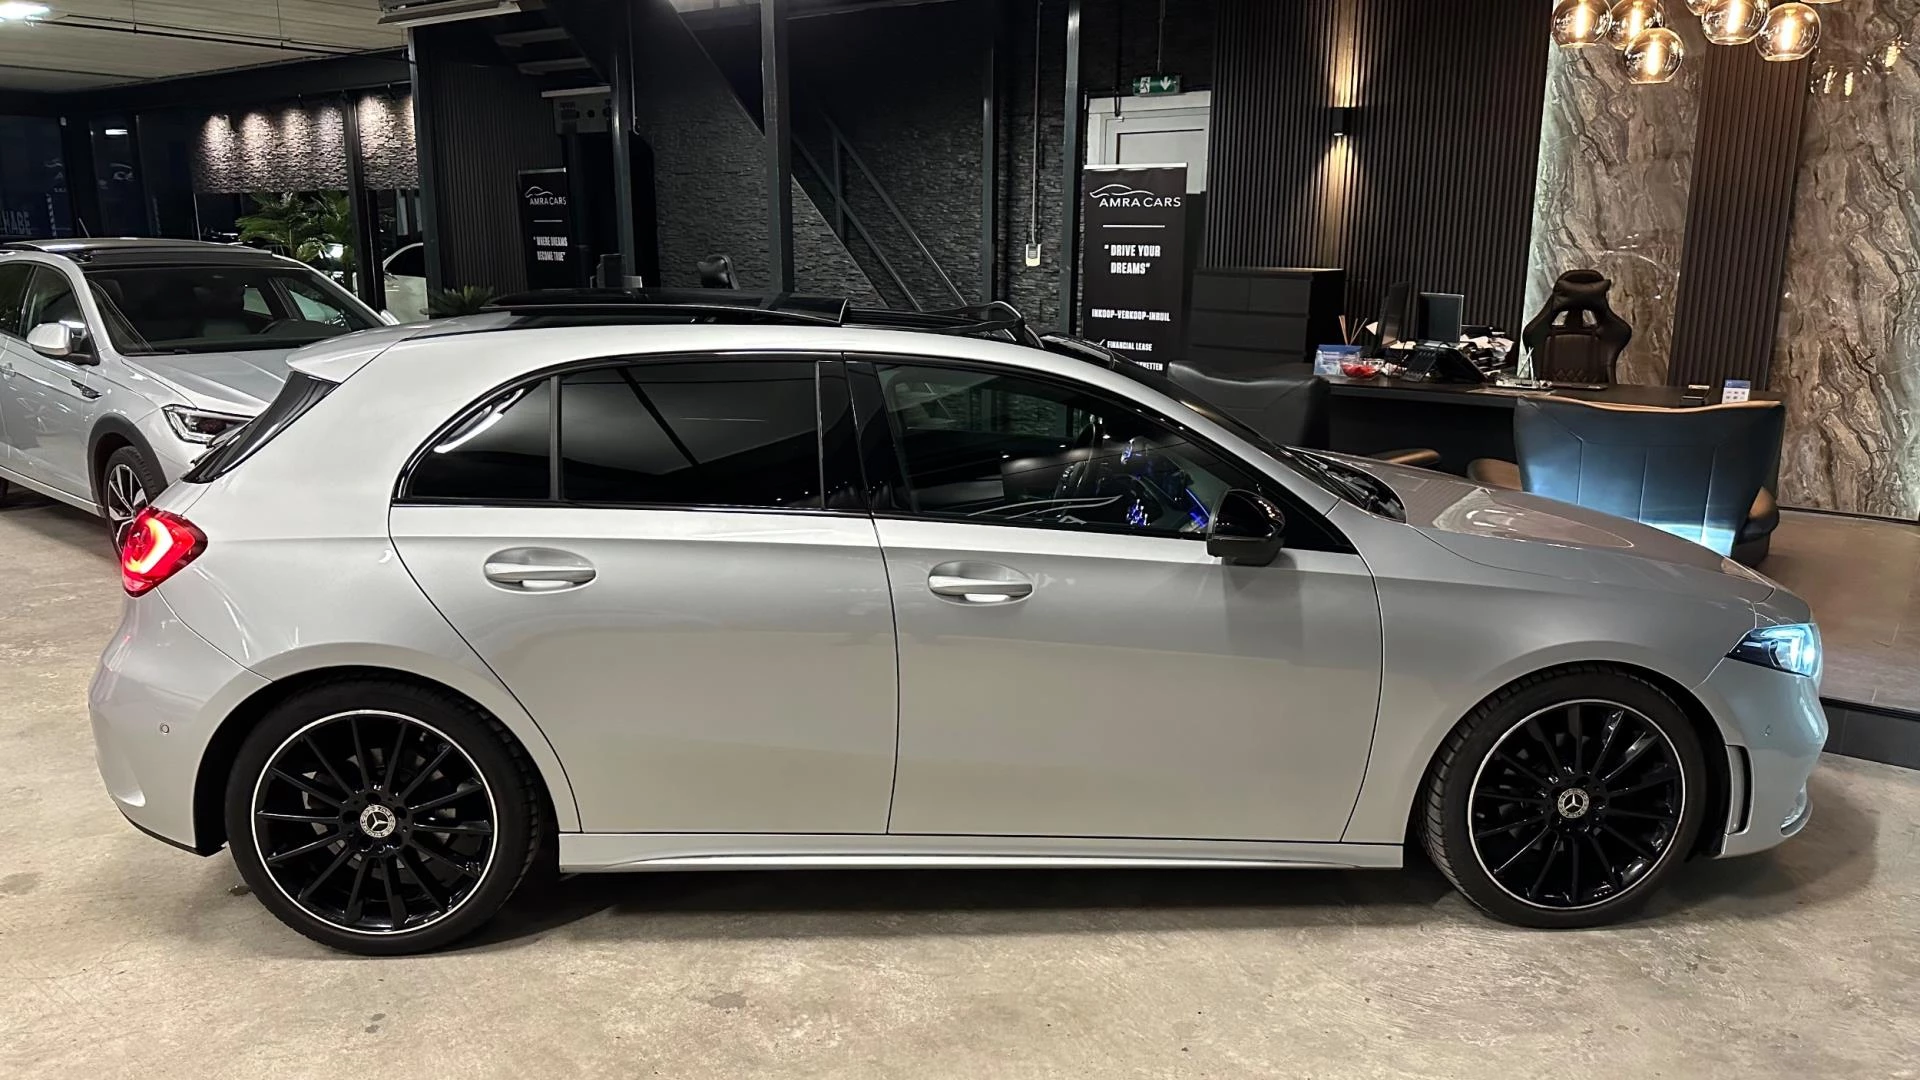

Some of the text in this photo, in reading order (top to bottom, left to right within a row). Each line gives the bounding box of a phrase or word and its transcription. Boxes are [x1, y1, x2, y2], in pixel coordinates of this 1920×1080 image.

[529, 197, 566, 205] AMRA CARS
[1099, 197, 1181, 208] AMRA CARS
[1138, 245, 1161, 257] YOUR
[1107, 340, 1153, 352] FINANCIAL LEASE
